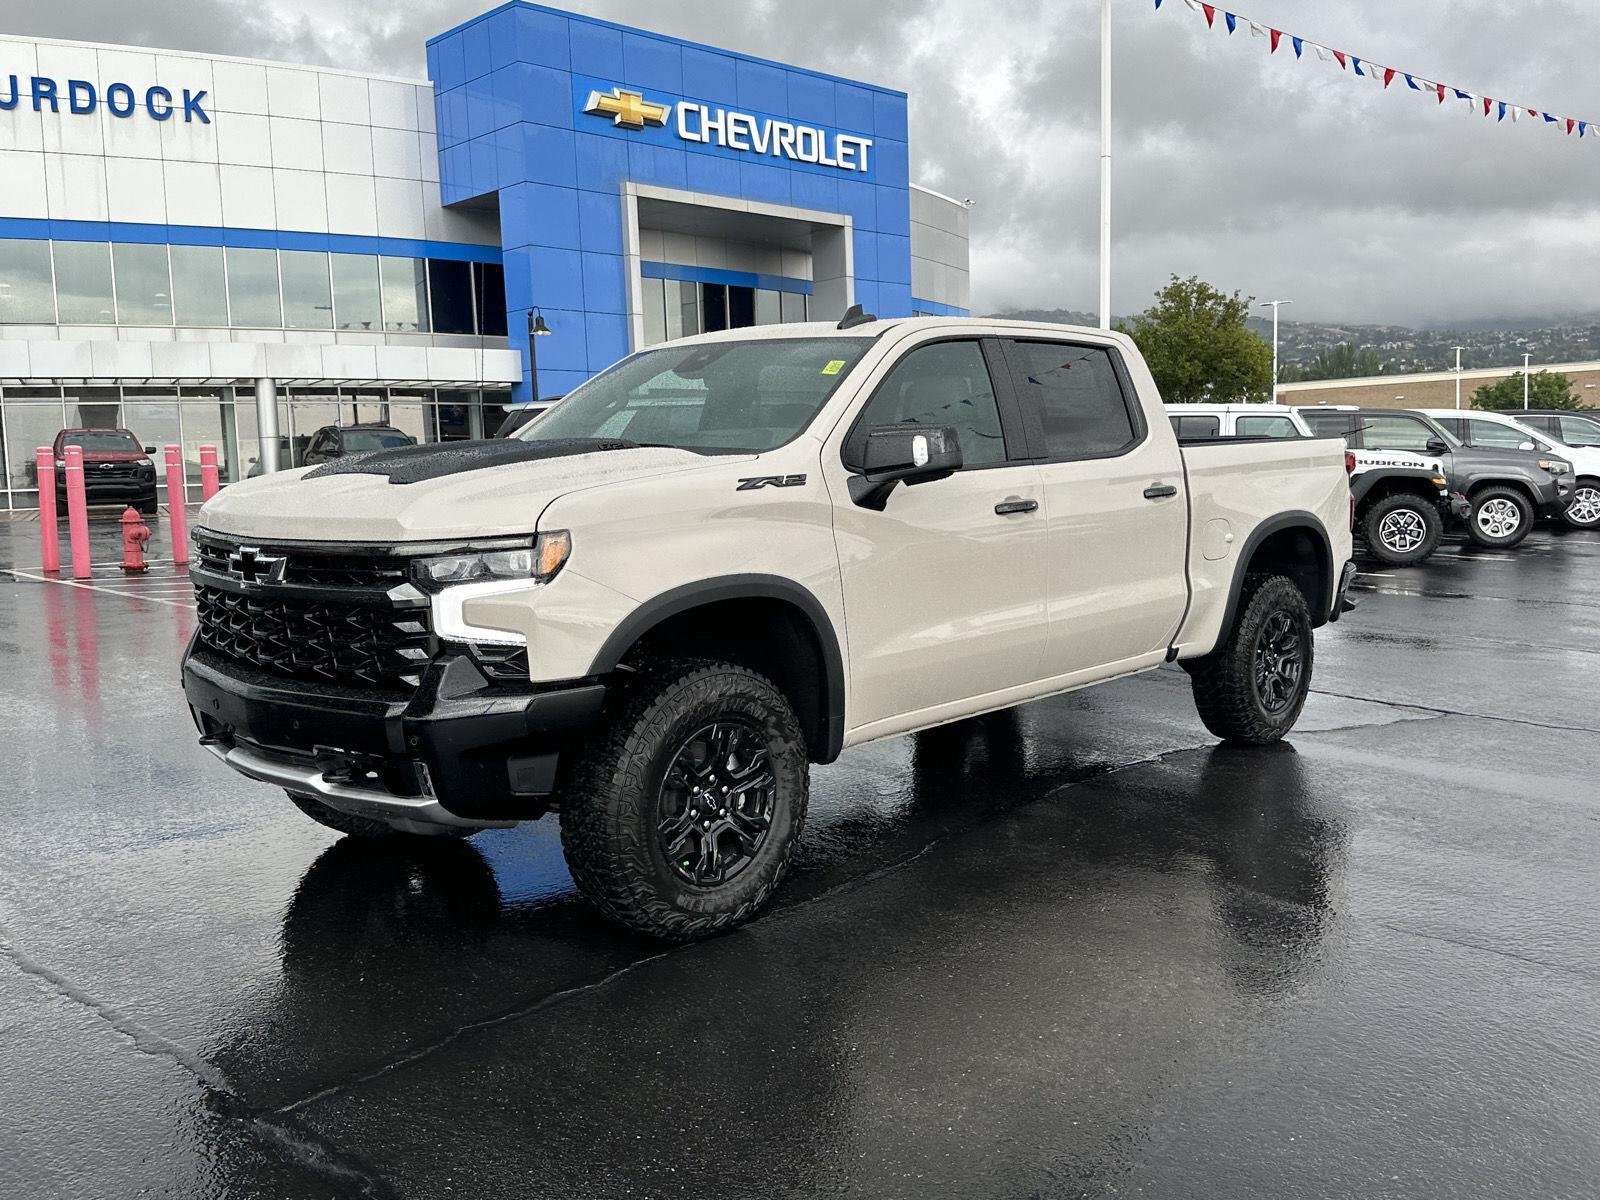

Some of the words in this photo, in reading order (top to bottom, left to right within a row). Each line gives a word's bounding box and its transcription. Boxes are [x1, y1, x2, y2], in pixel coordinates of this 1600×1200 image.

[0, 75, 210, 124] URDOCK
[677, 101, 872, 172] CHEVROLET
[736, 473, 807, 491] ZR2
